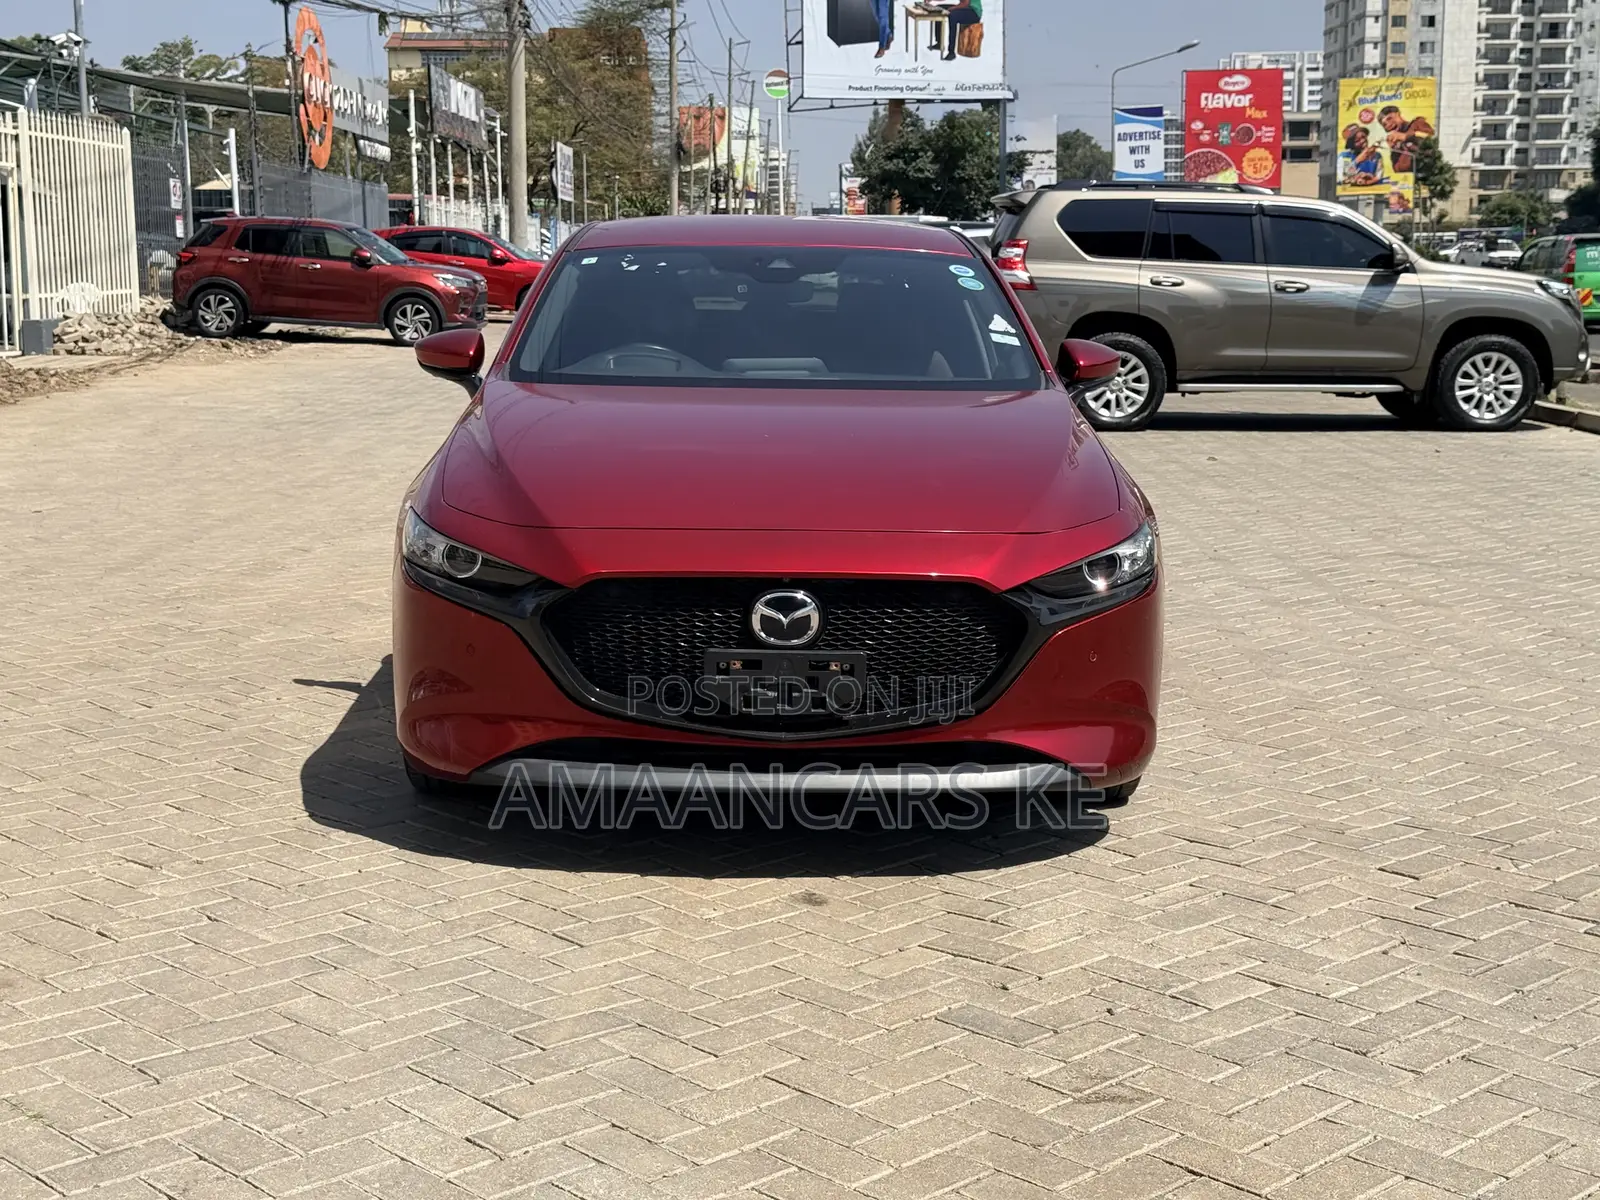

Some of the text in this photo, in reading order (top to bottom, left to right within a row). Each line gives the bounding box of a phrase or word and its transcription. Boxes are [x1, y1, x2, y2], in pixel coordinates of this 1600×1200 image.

[875, 65, 934, 76] Growing with You
[874, 84, 904, 93] Financing
[1358, 95, 1377, 105] Blue
[1379, 92, 1402, 103] Band
[1245, 107, 1268, 119] Max
[1117, 130, 1162, 142] ADVERTISE
[1128, 144, 1150, 155] WITH
[1134, 158, 1145, 169] US
